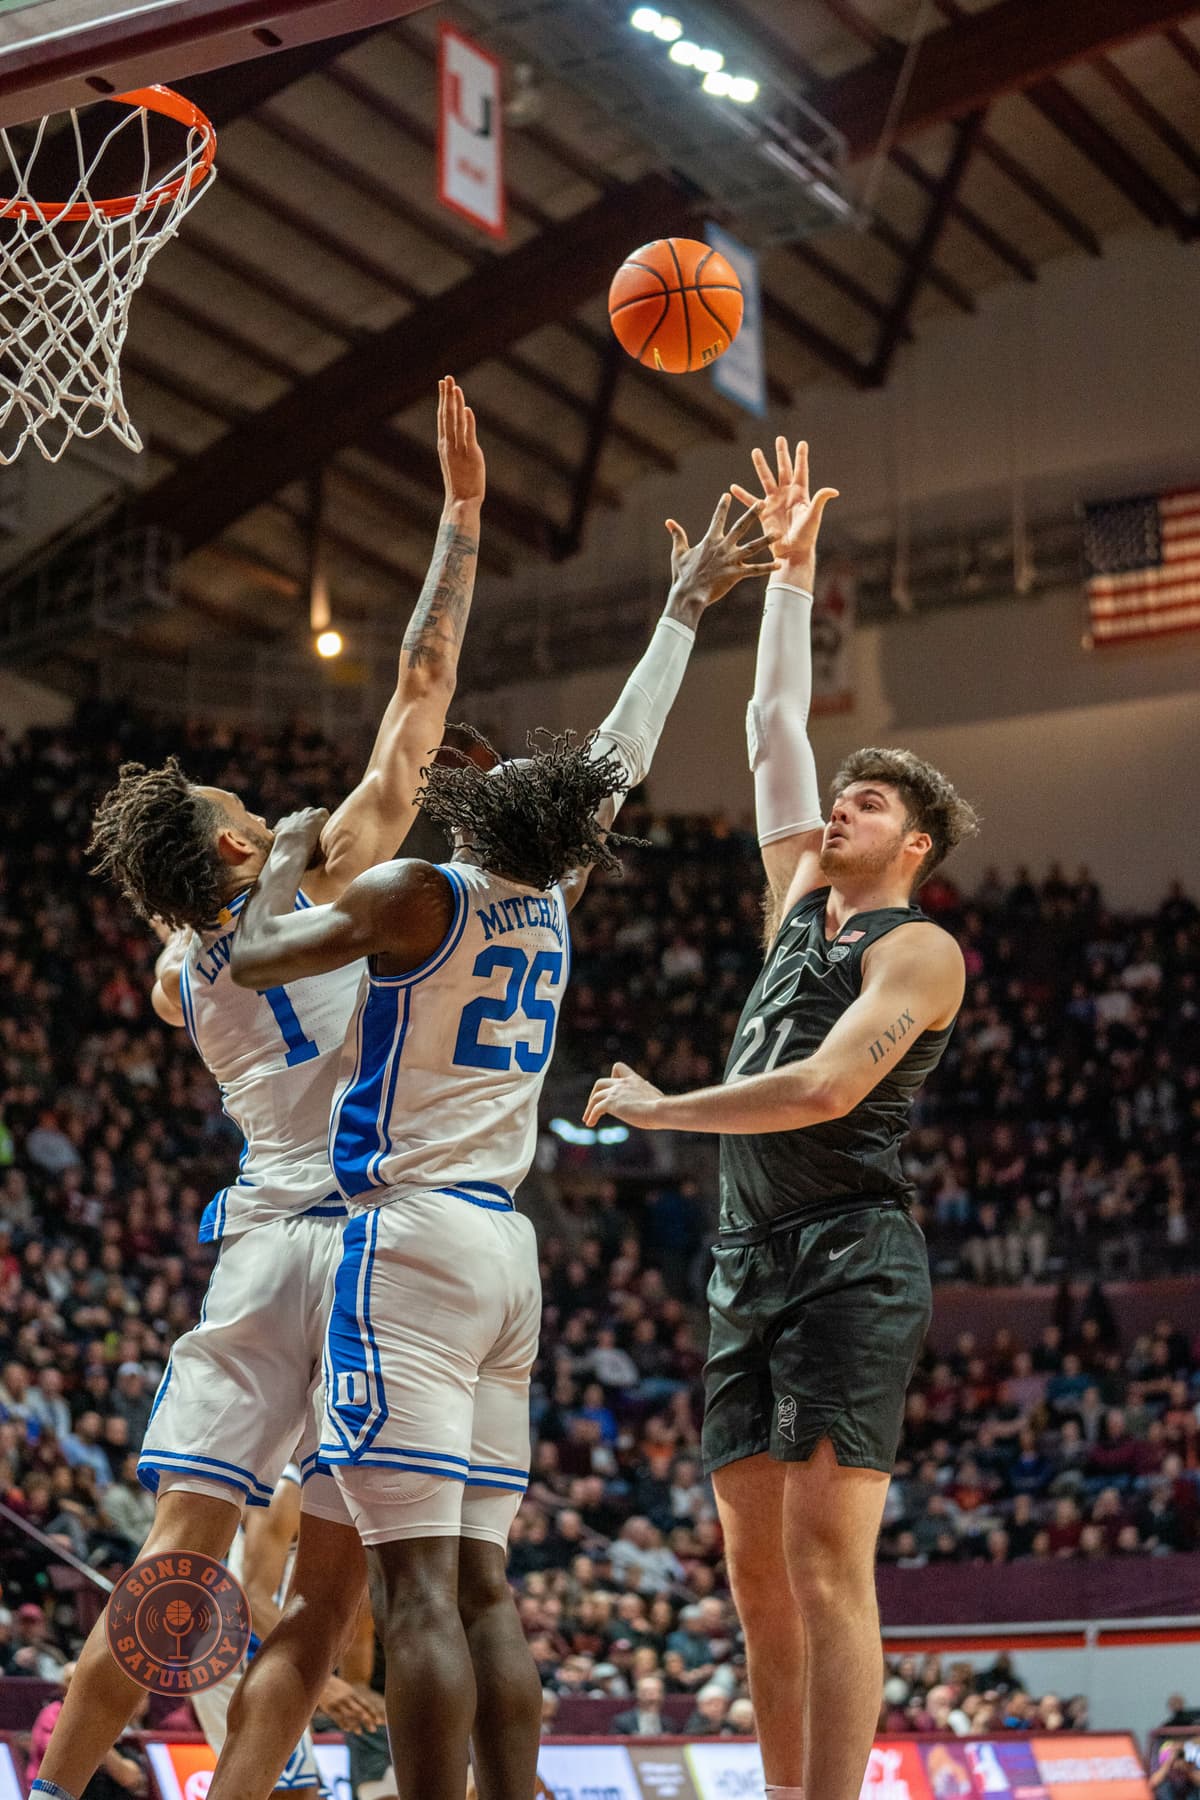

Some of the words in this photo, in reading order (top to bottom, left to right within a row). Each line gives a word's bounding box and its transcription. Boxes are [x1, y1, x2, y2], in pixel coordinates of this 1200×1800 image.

[475, 895, 563, 948] MITCH
[196, 931, 235, 985] LIV
[452, 944, 563, 1073] 25
[725, 1016, 795, 1084] 21
[334, 1370, 367, 1407] D
